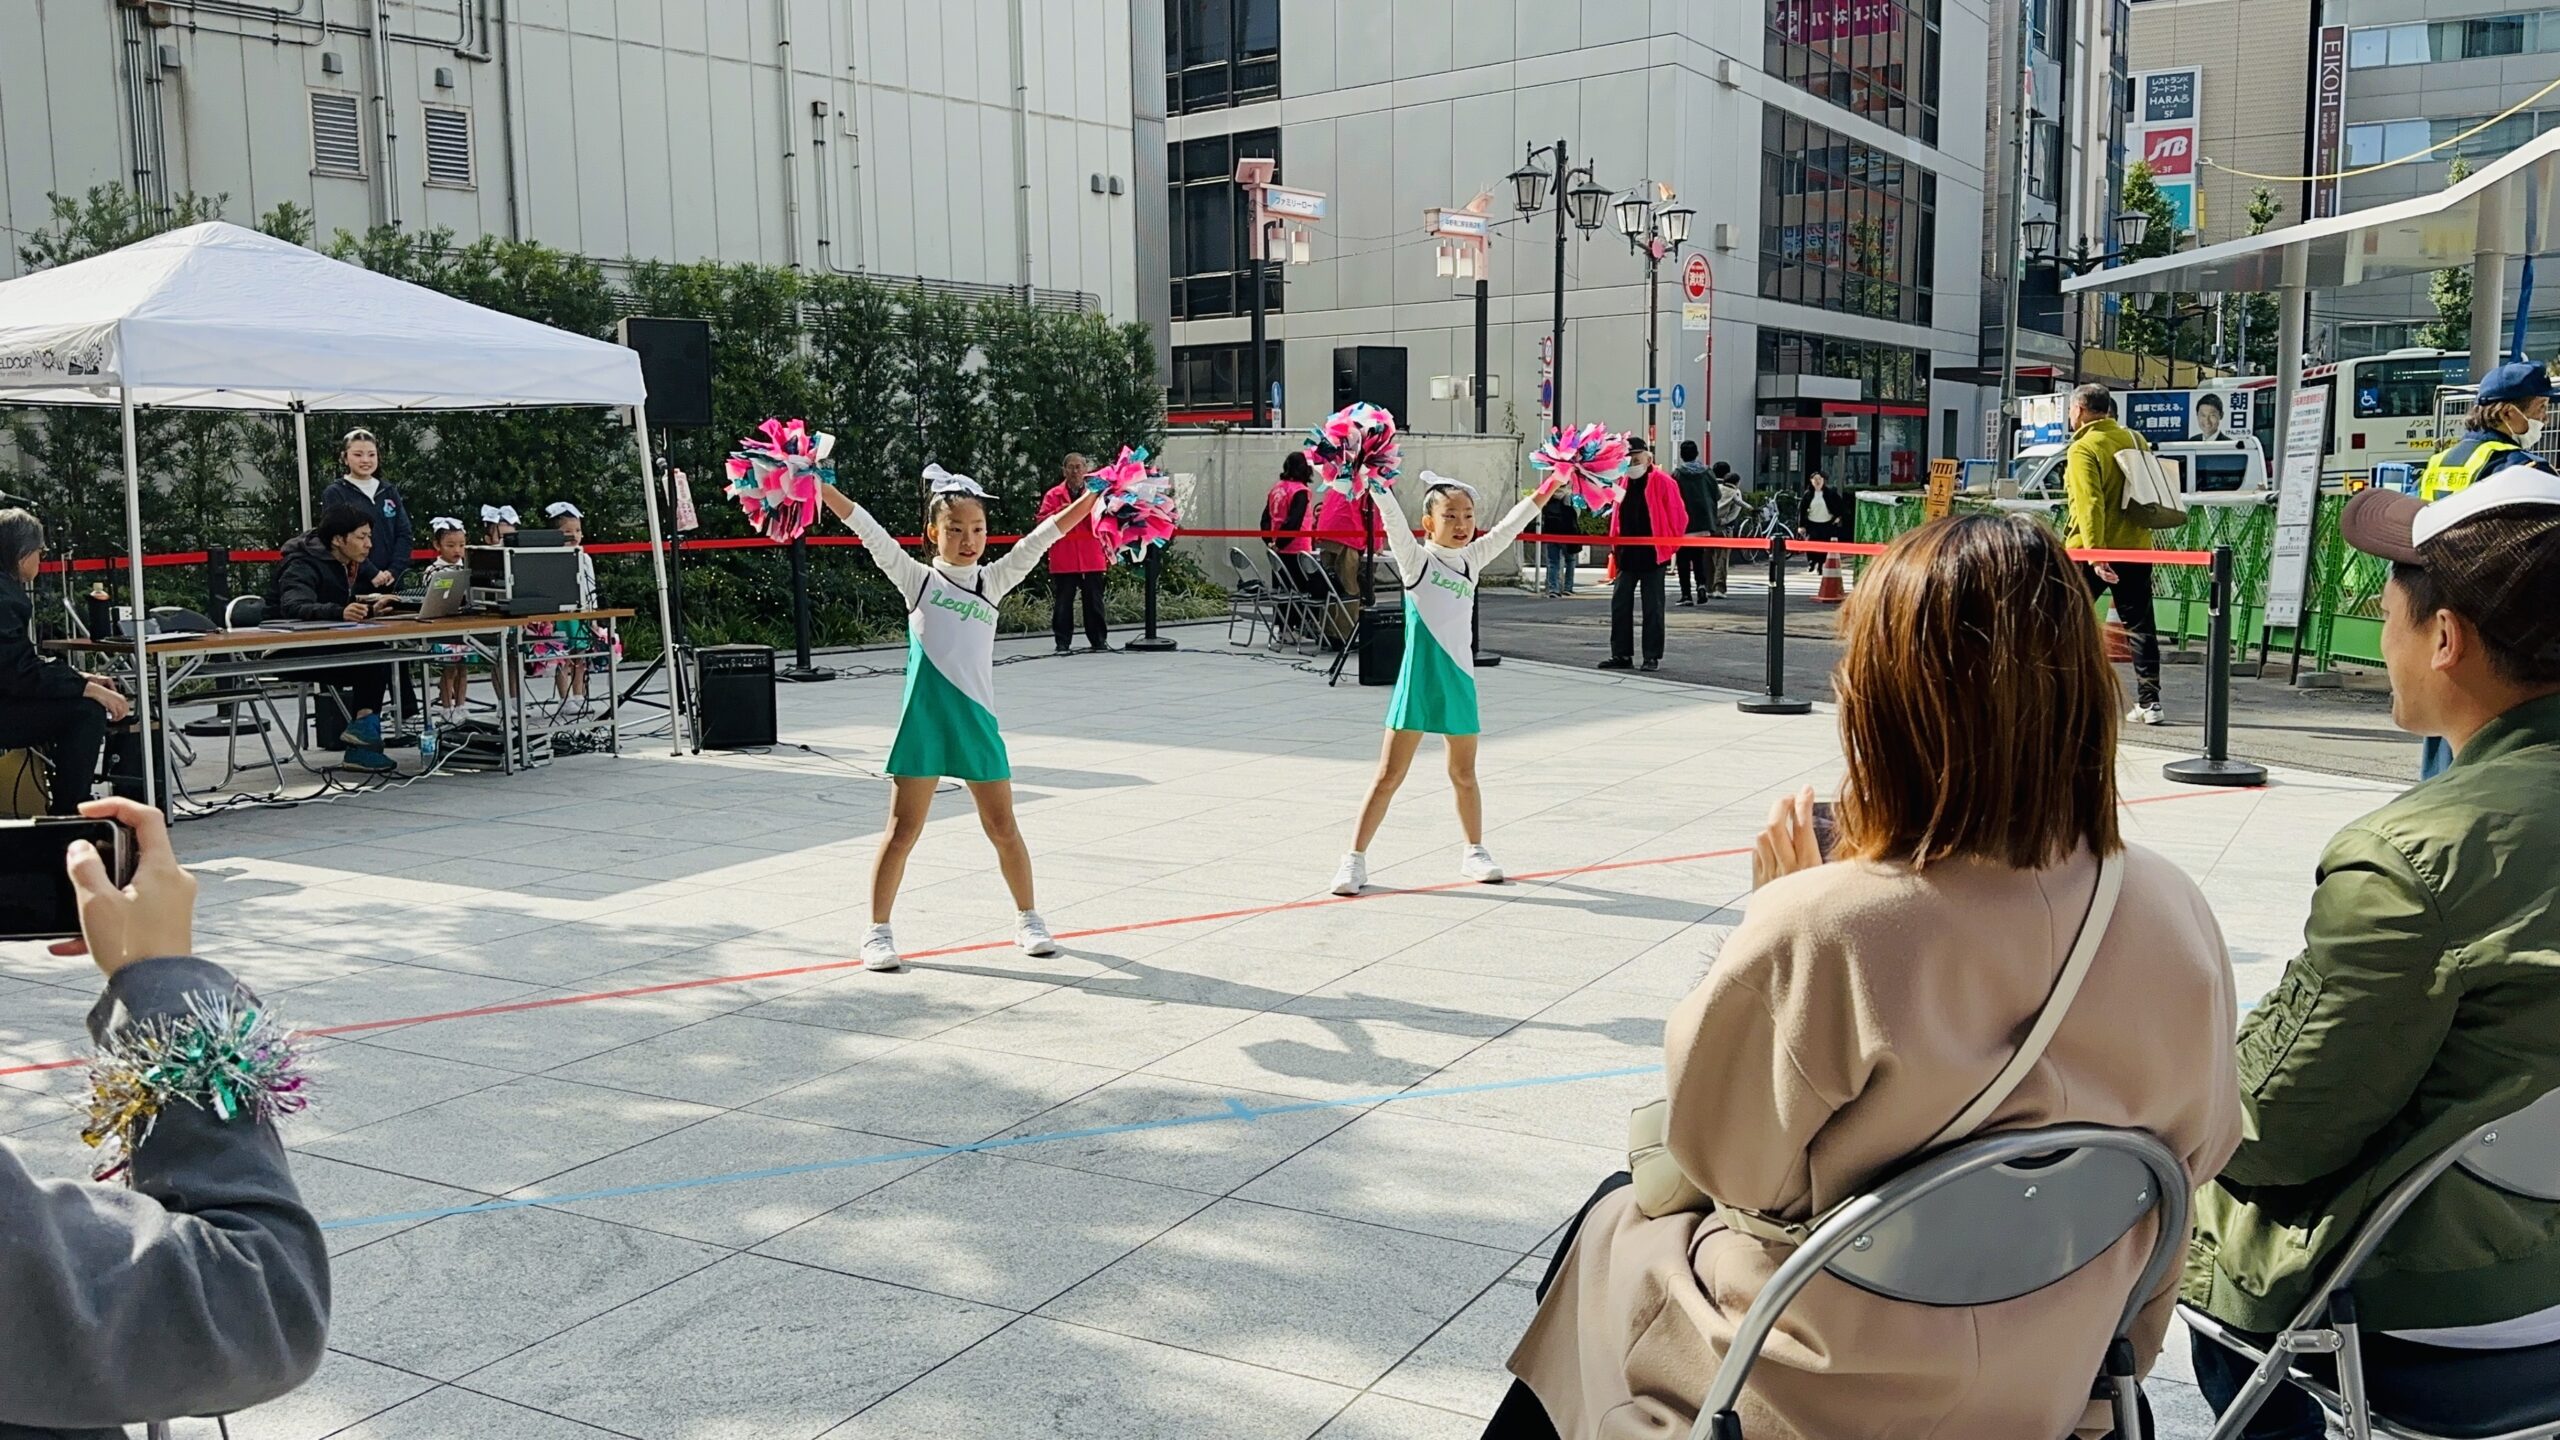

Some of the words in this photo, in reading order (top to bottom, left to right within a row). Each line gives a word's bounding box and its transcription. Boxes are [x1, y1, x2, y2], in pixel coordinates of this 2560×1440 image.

[2321, 41, 2341, 106] EIKOH
[2152, 84, 2189, 94] フードコート
[2164, 110, 2174, 118] 5F
[2148, 135, 2188, 161] JTB
[2230, 392, 2248, 428] 朝日
[2146, 416, 2181, 428] 自民党
